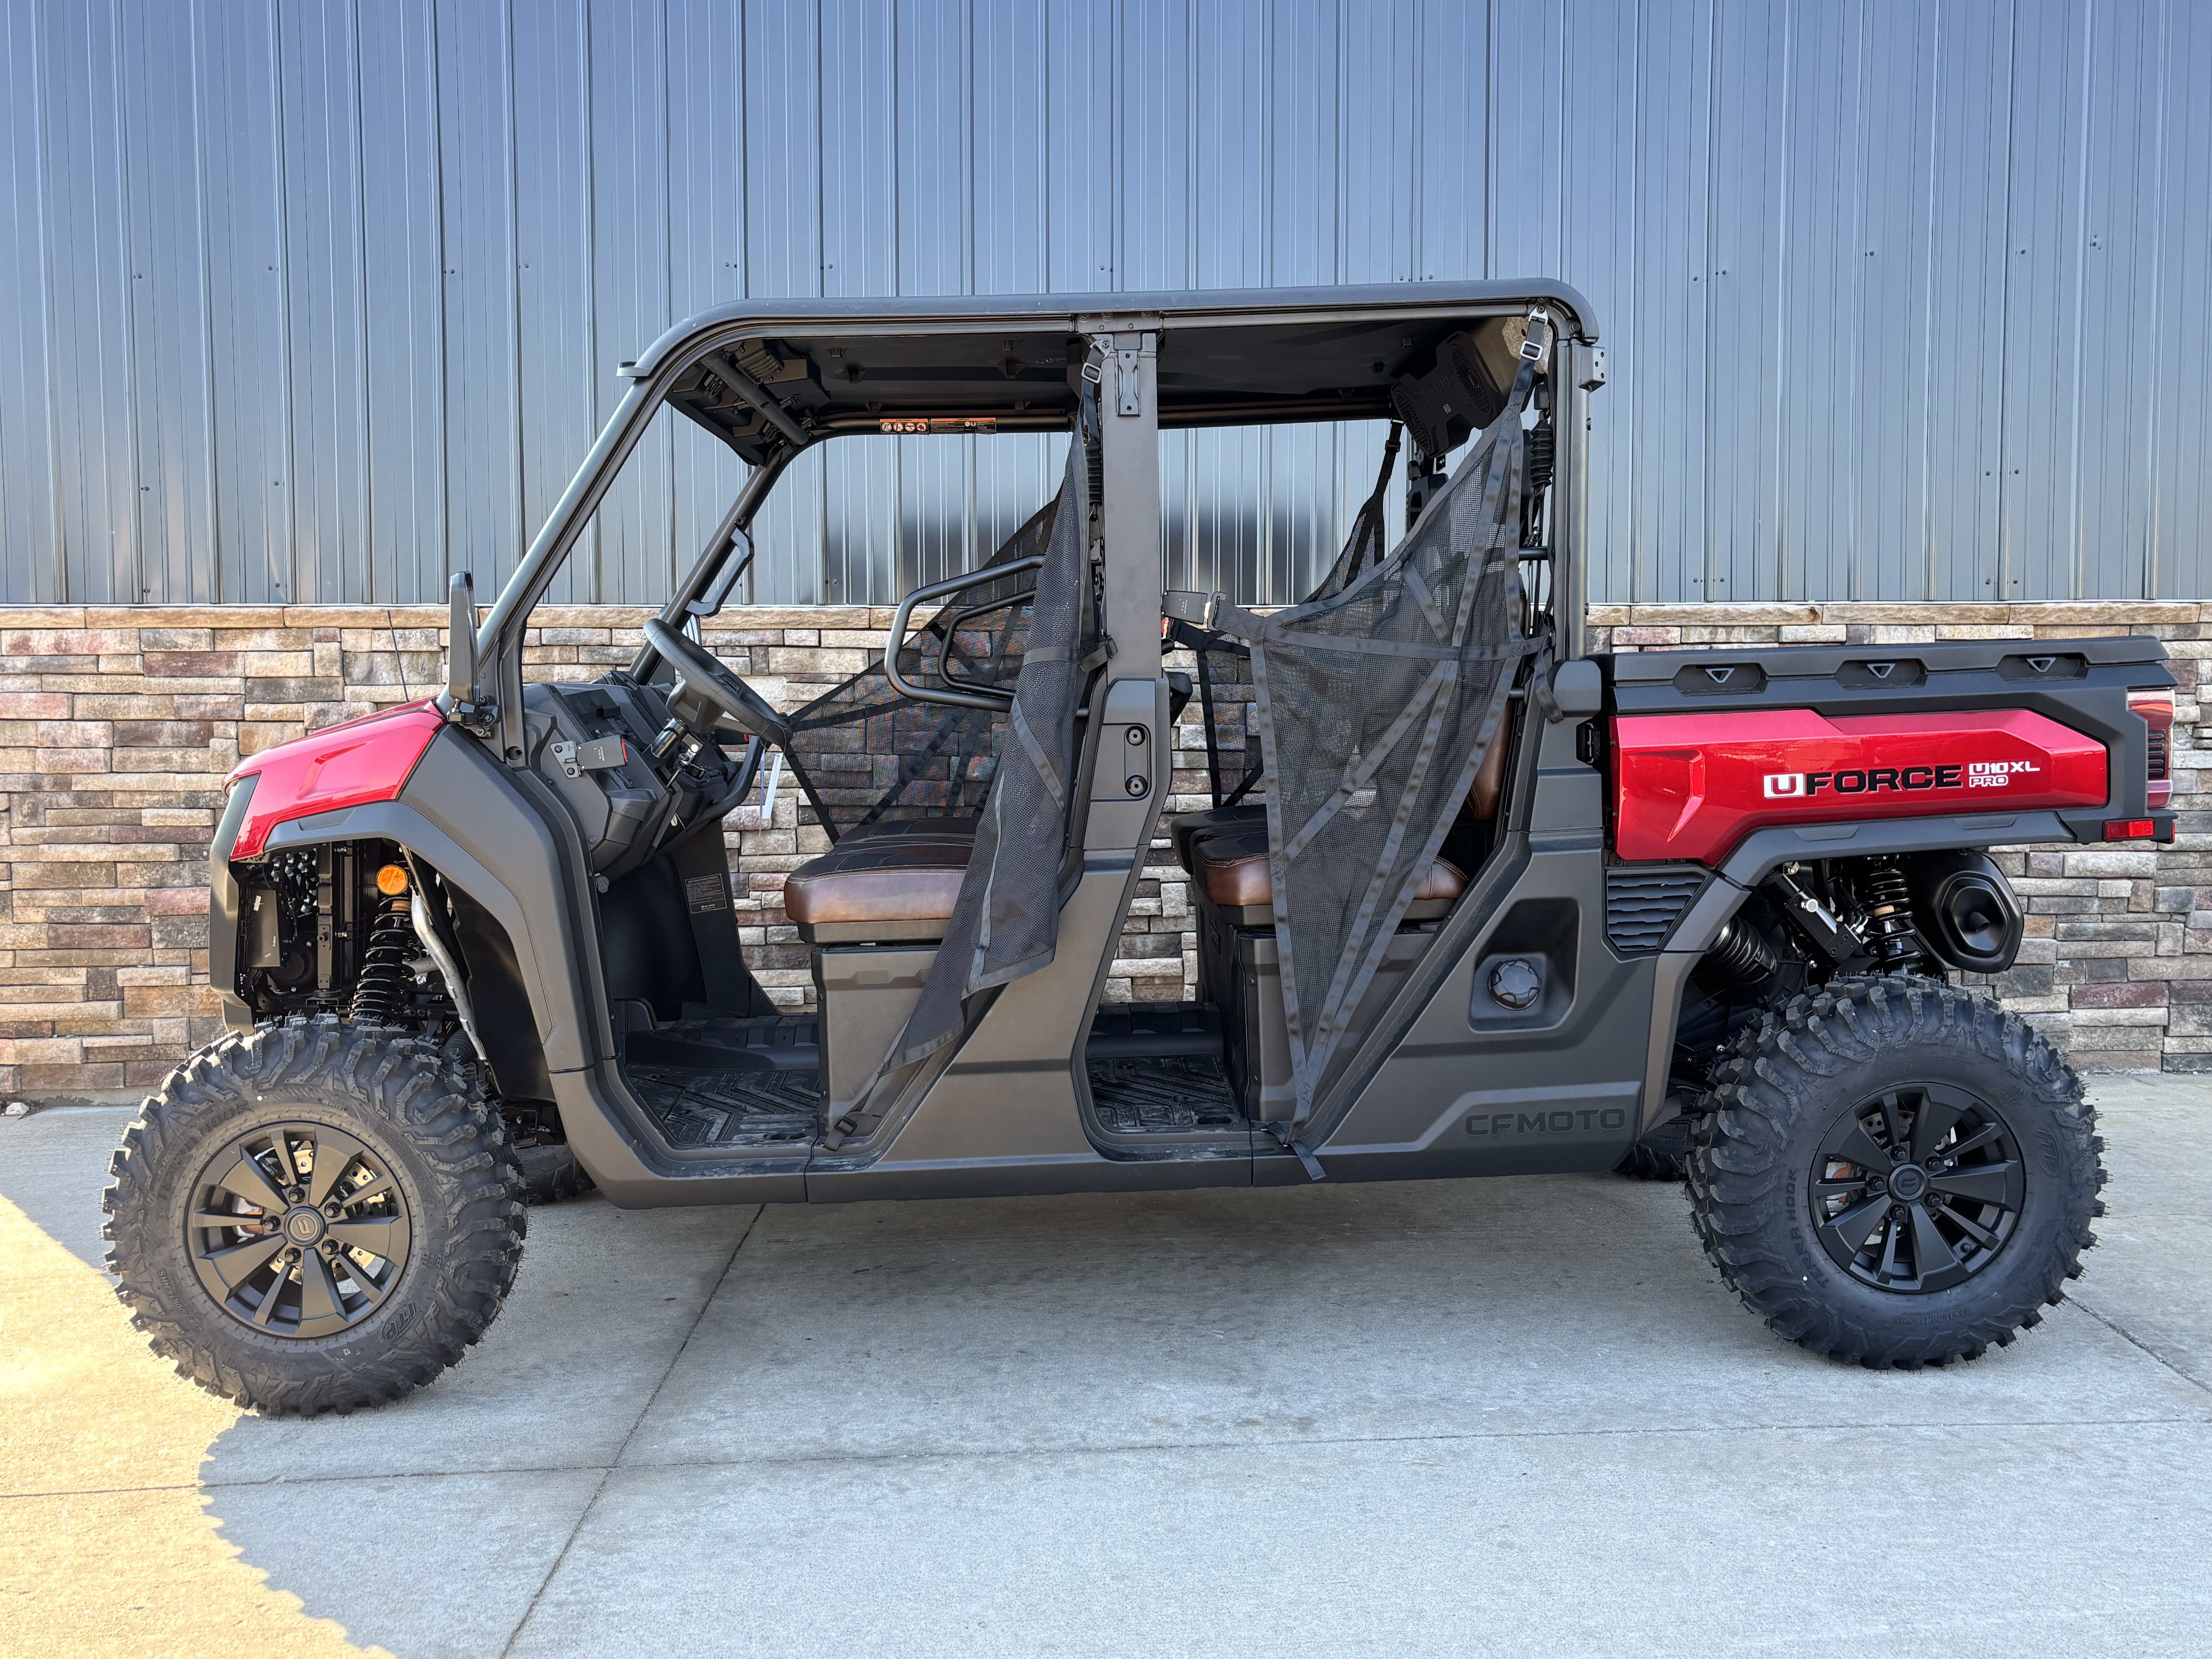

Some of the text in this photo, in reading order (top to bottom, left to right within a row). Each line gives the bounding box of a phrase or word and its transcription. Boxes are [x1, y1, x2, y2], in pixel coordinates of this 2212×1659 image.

[1969, 775, 2009, 788] PRO
[199, 1100, 254, 1138] HOOK
[1465, 1108, 1625, 1136] CFMOTO
[1786, 1168, 1798, 1221] HOOK
[385, 1302, 416, 1341] ITP
